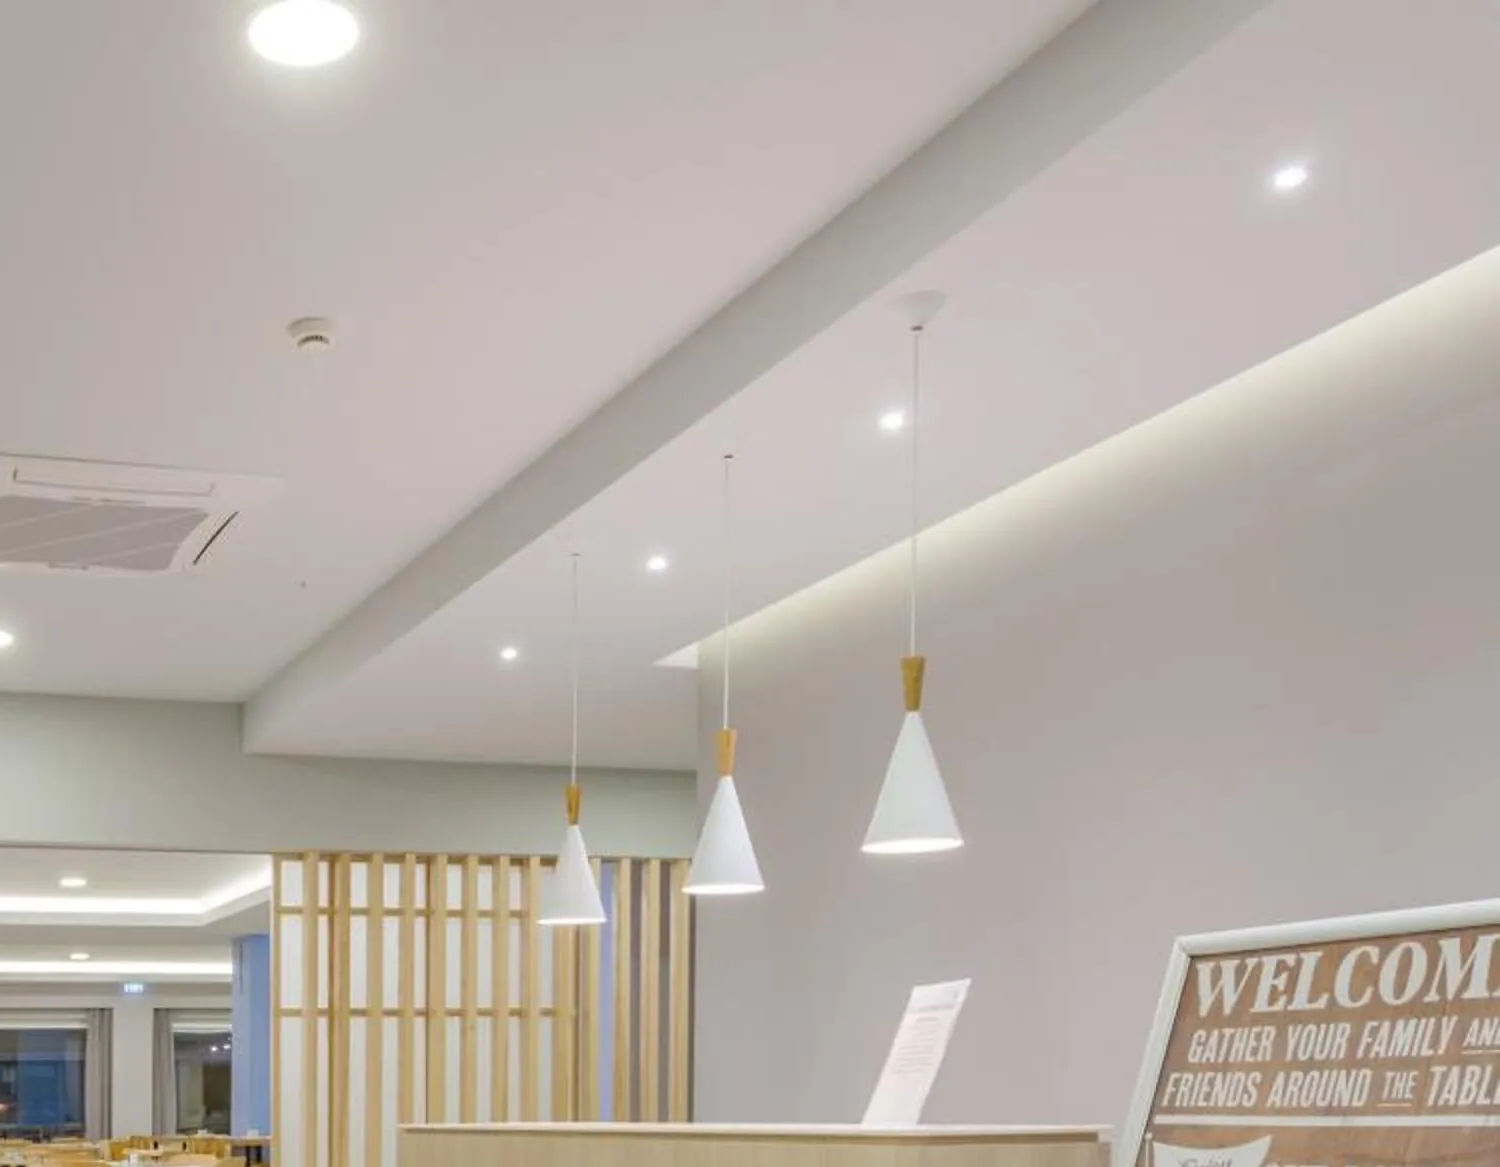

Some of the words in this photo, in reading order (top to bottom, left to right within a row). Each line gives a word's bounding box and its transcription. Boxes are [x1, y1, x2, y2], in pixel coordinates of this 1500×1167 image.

[1196, 934, 1500, 1018] WELCOM
[1187, 1025, 1276, 1064] GATHER
[1284, 1022, 1352, 1062] YOUR
[1356, 1015, 1459, 1060] FAMILY
[1463, 1017, 1500, 1047] AN
[1162, 1071, 1262, 1108] FRIENDS
[1266, 1068, 1374, 1108] AROUND
[1381, 1071, 1418, 1100] THE
[1427, 1064, 1500, 1107] TABL
